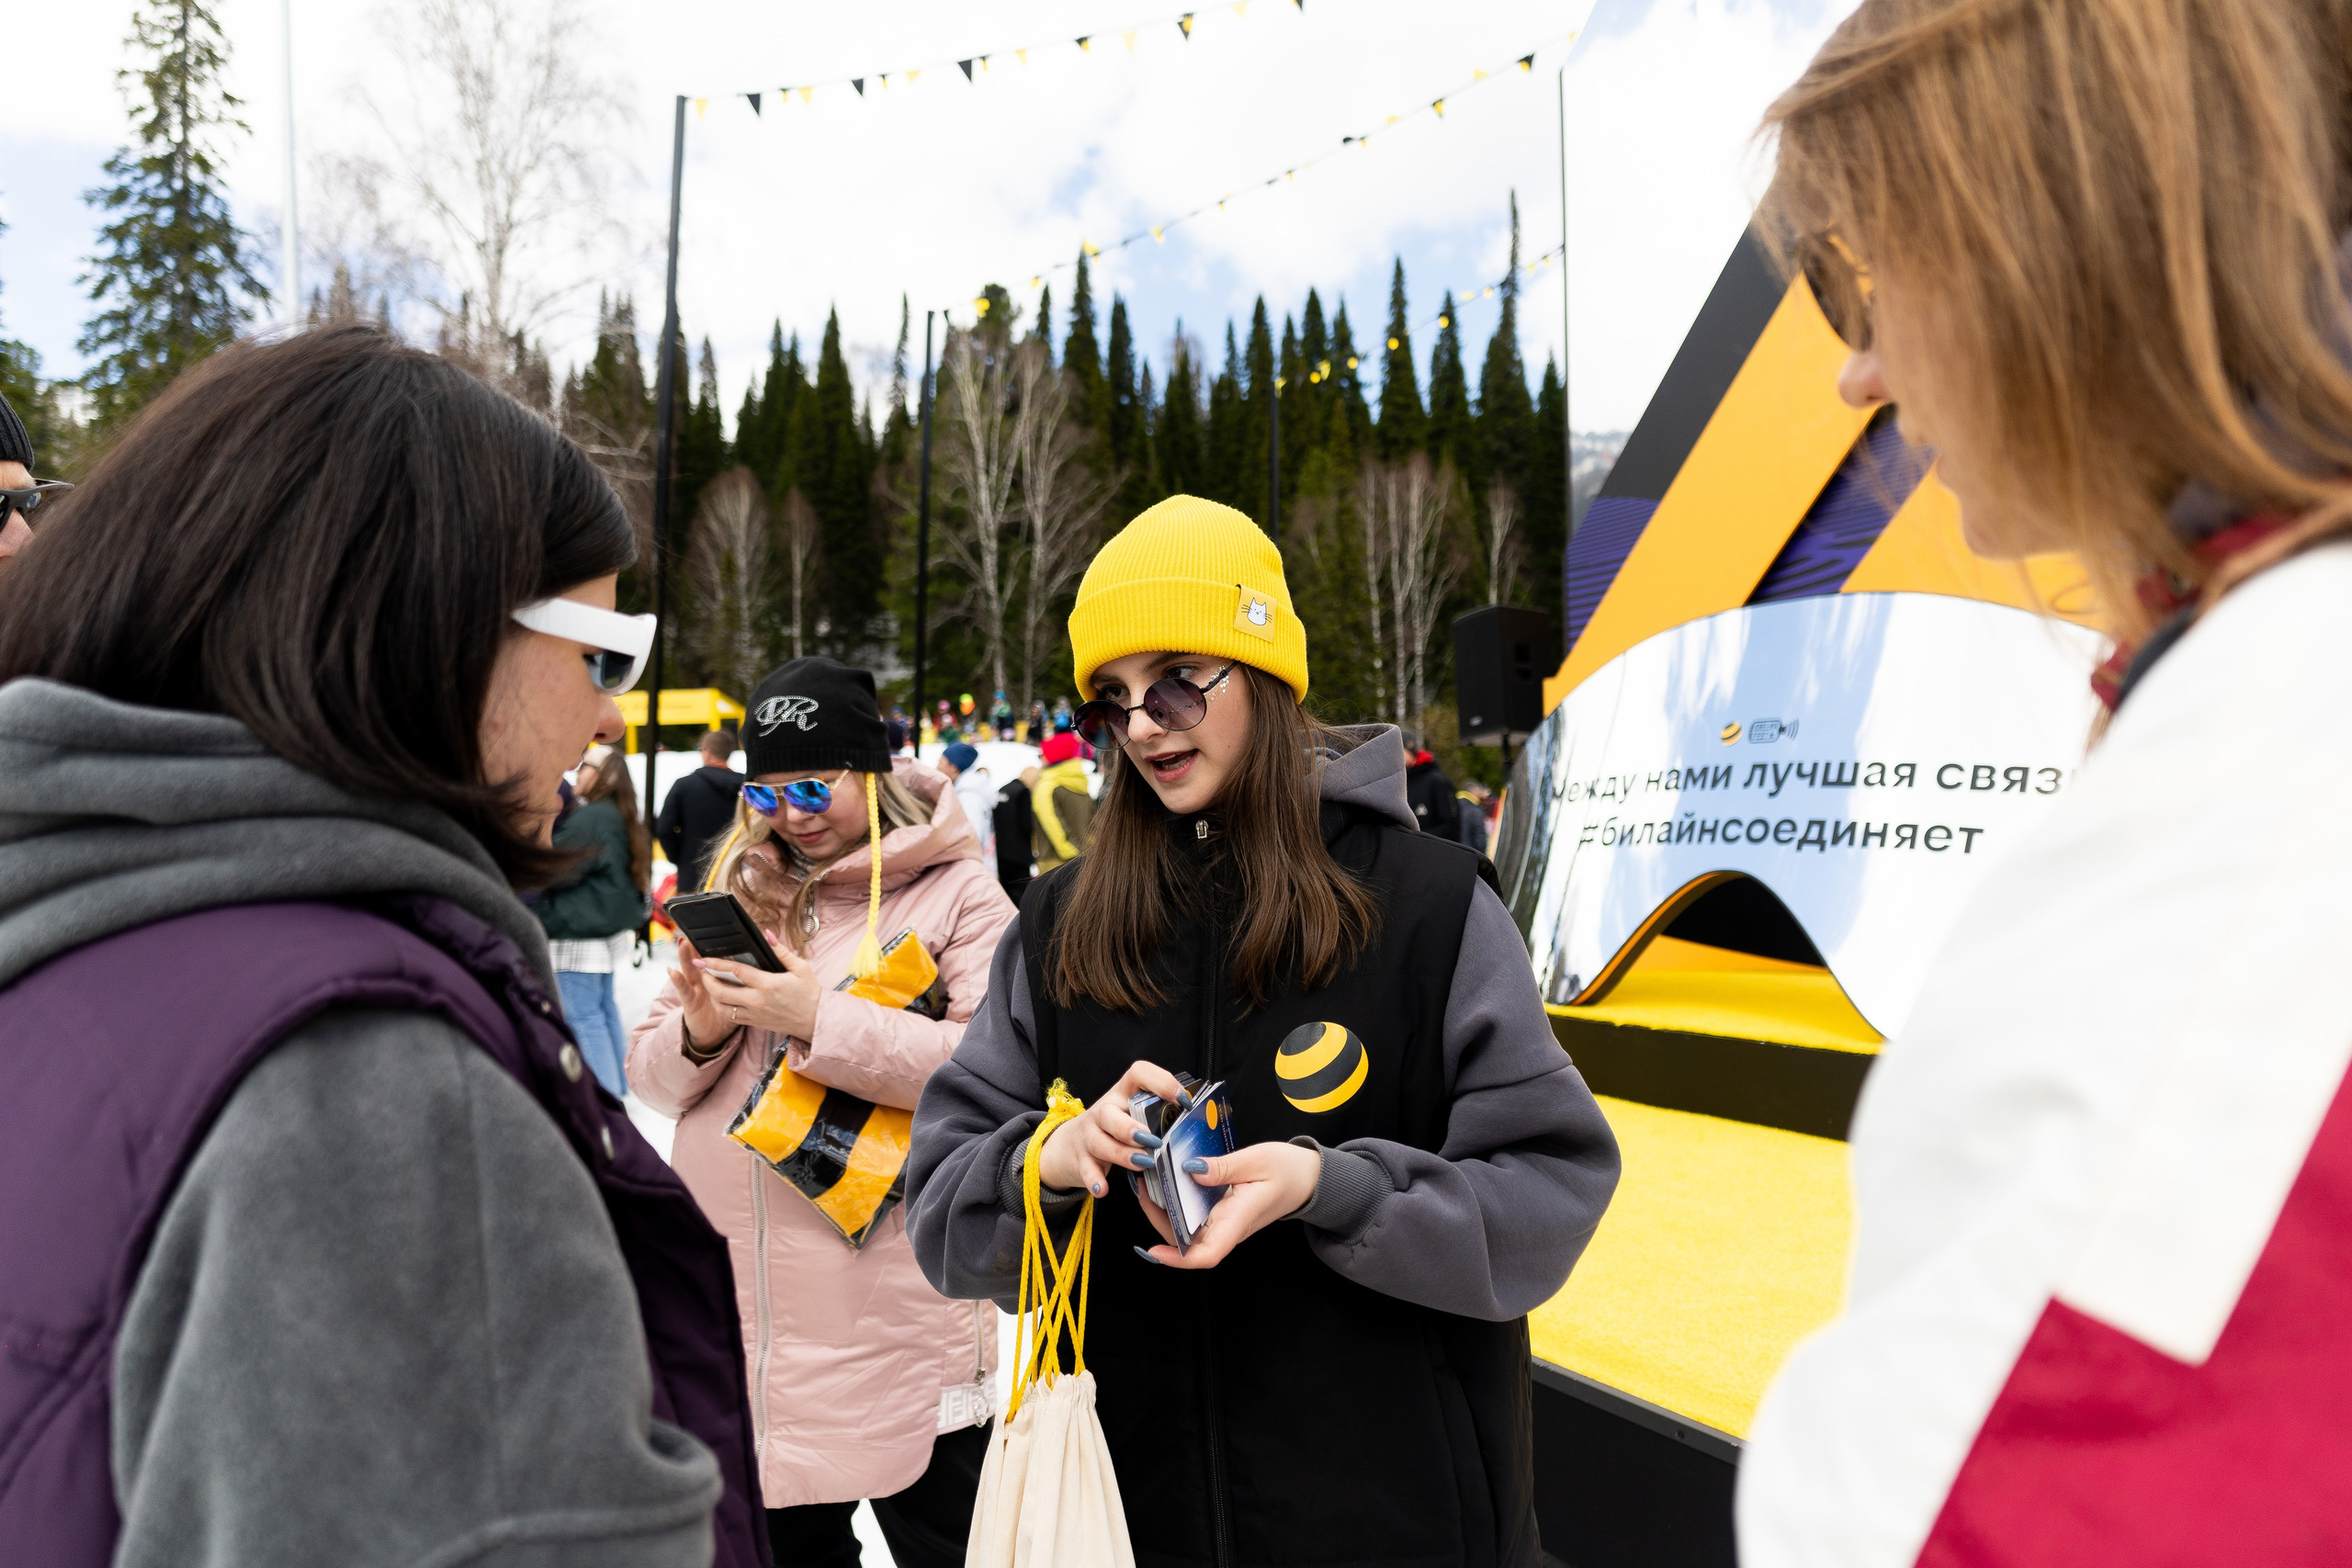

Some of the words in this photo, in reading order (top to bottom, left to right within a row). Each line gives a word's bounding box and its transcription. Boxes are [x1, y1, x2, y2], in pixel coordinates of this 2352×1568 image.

[1645, 764, 1734, 793] нами
[1743, 761, 1917, 797] лучшая
[1936, 763, 2078, 795] связ
[1578, 811, 1984, 854] #билайнсоединяет
